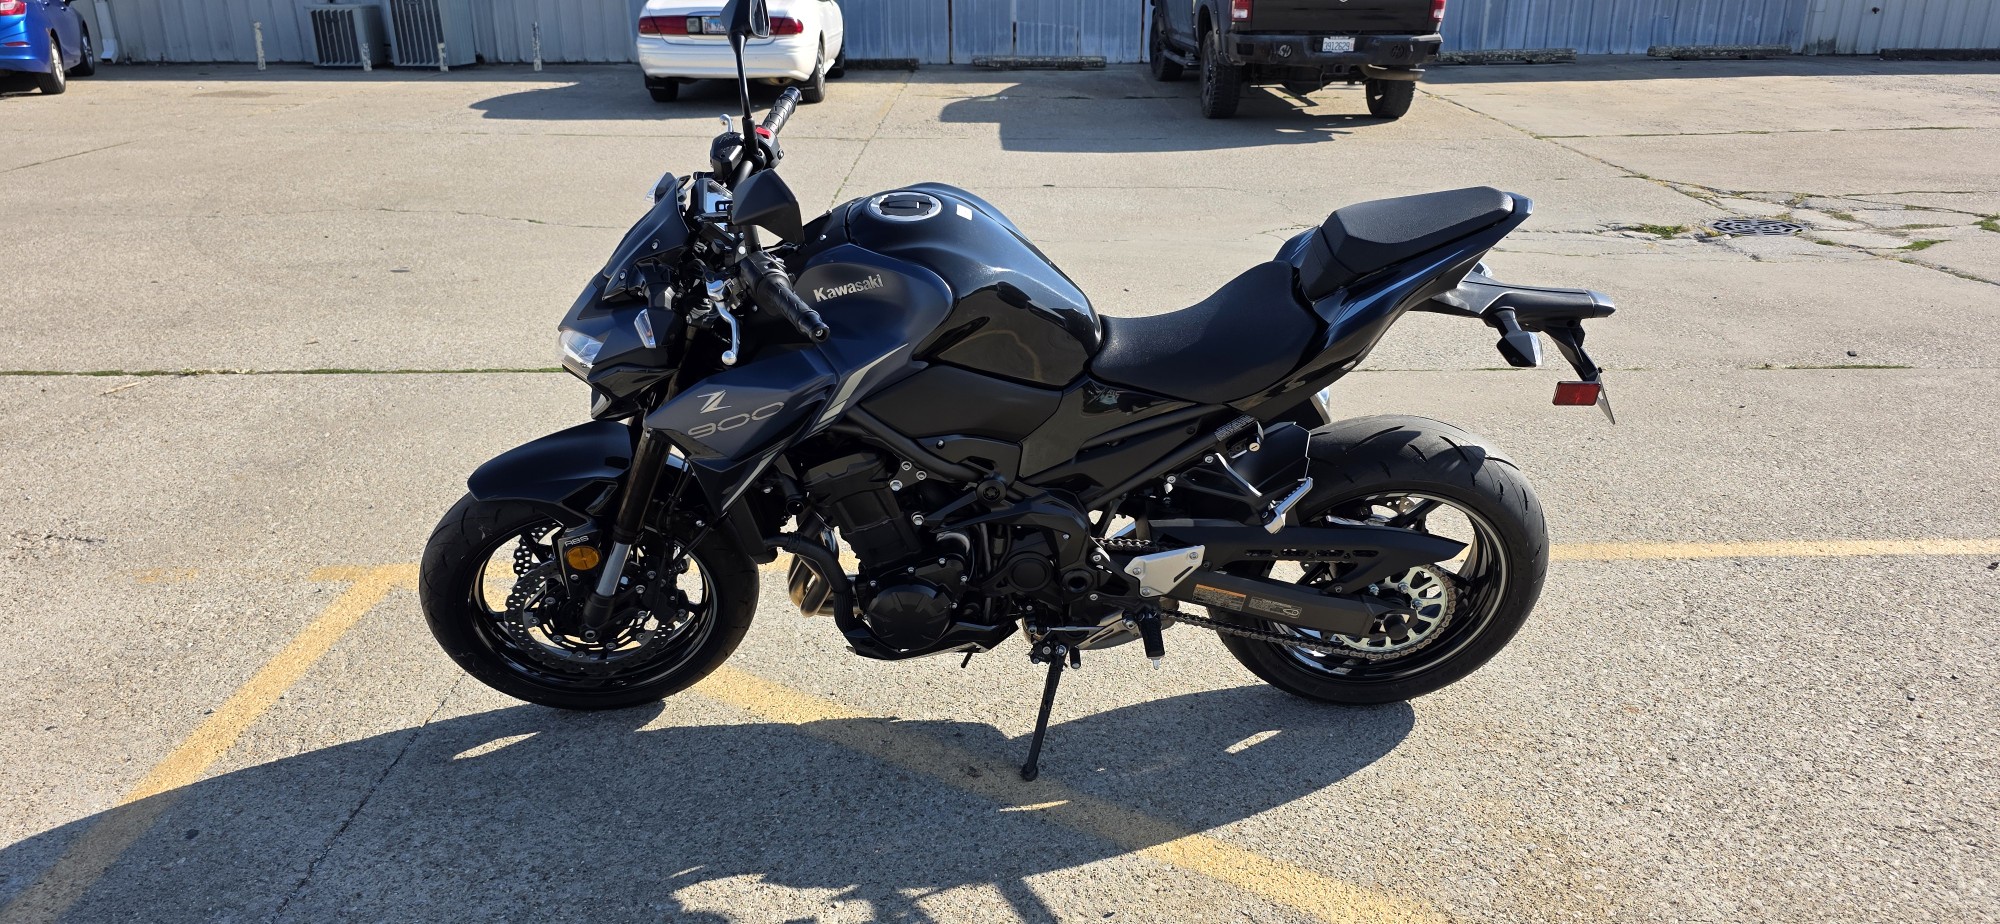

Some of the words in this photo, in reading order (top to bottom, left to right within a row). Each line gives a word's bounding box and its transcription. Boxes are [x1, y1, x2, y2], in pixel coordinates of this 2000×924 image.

[813, 273, 884, 302] Kawasaki
[687, 401, 785, 439] 900
[564, 535, 590, 547] ABS
